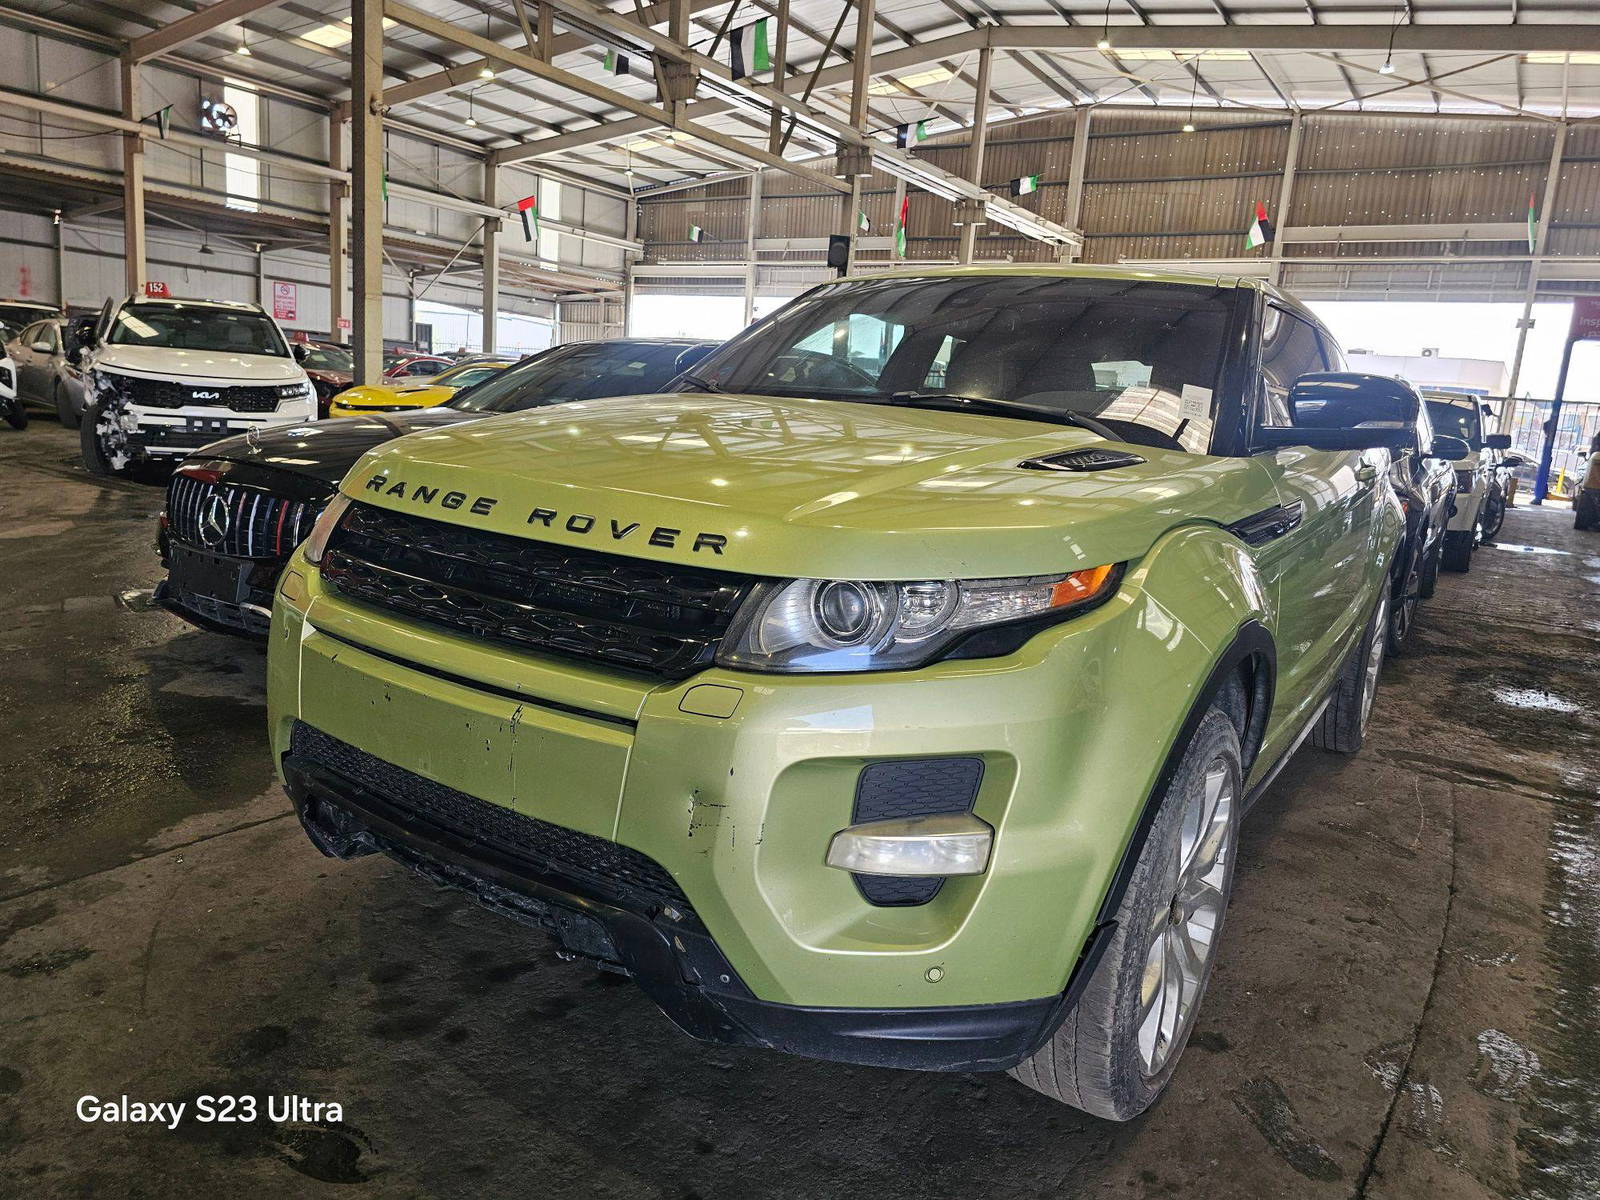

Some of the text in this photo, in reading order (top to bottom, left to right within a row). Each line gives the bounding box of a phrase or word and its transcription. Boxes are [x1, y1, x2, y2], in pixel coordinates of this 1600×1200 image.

[149, 282, 164, 293] 152
[365, 474, 728, 555] RANGE ROVER
